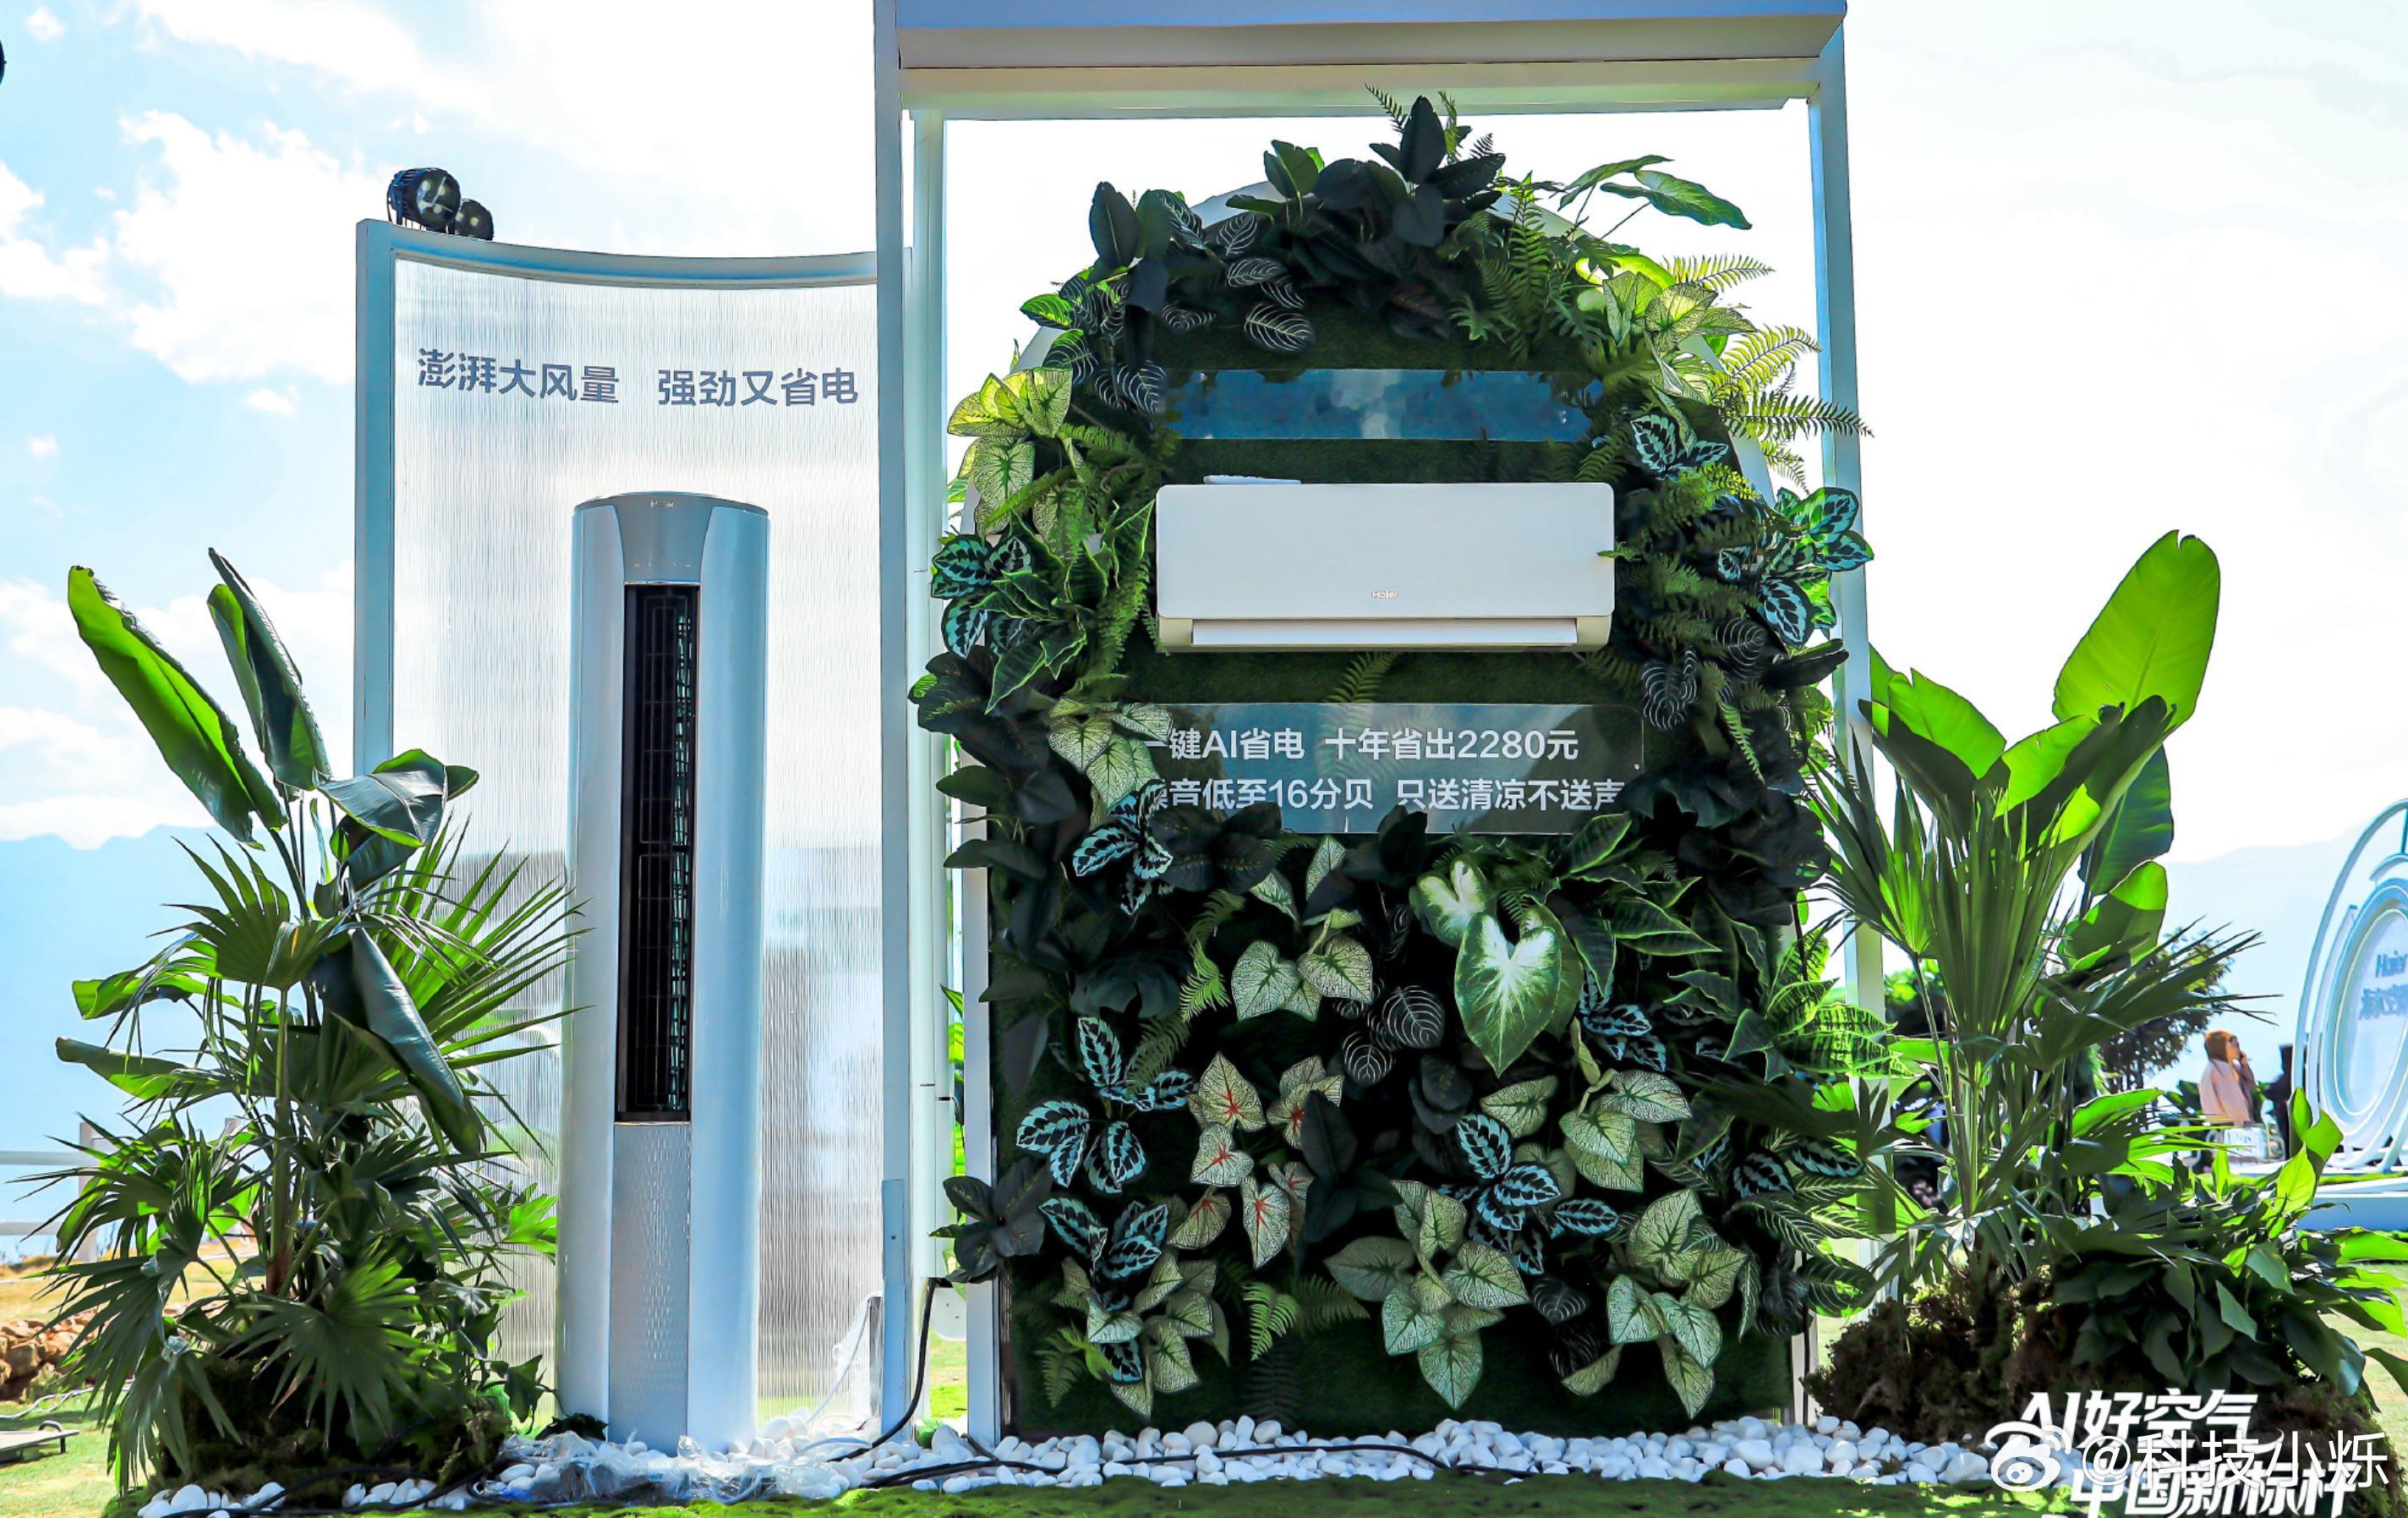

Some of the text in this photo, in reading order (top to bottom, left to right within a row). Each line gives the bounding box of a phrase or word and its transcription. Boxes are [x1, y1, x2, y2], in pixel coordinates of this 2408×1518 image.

[417, 347, 858, 407] 澎湃大风量 强劲又省电
[1371, 589, 1398, 600] Haier
[1325, 727, 1579, 760] 十年省出2280元
[1397, 778, 1625, 811] 只送清凉不送声
